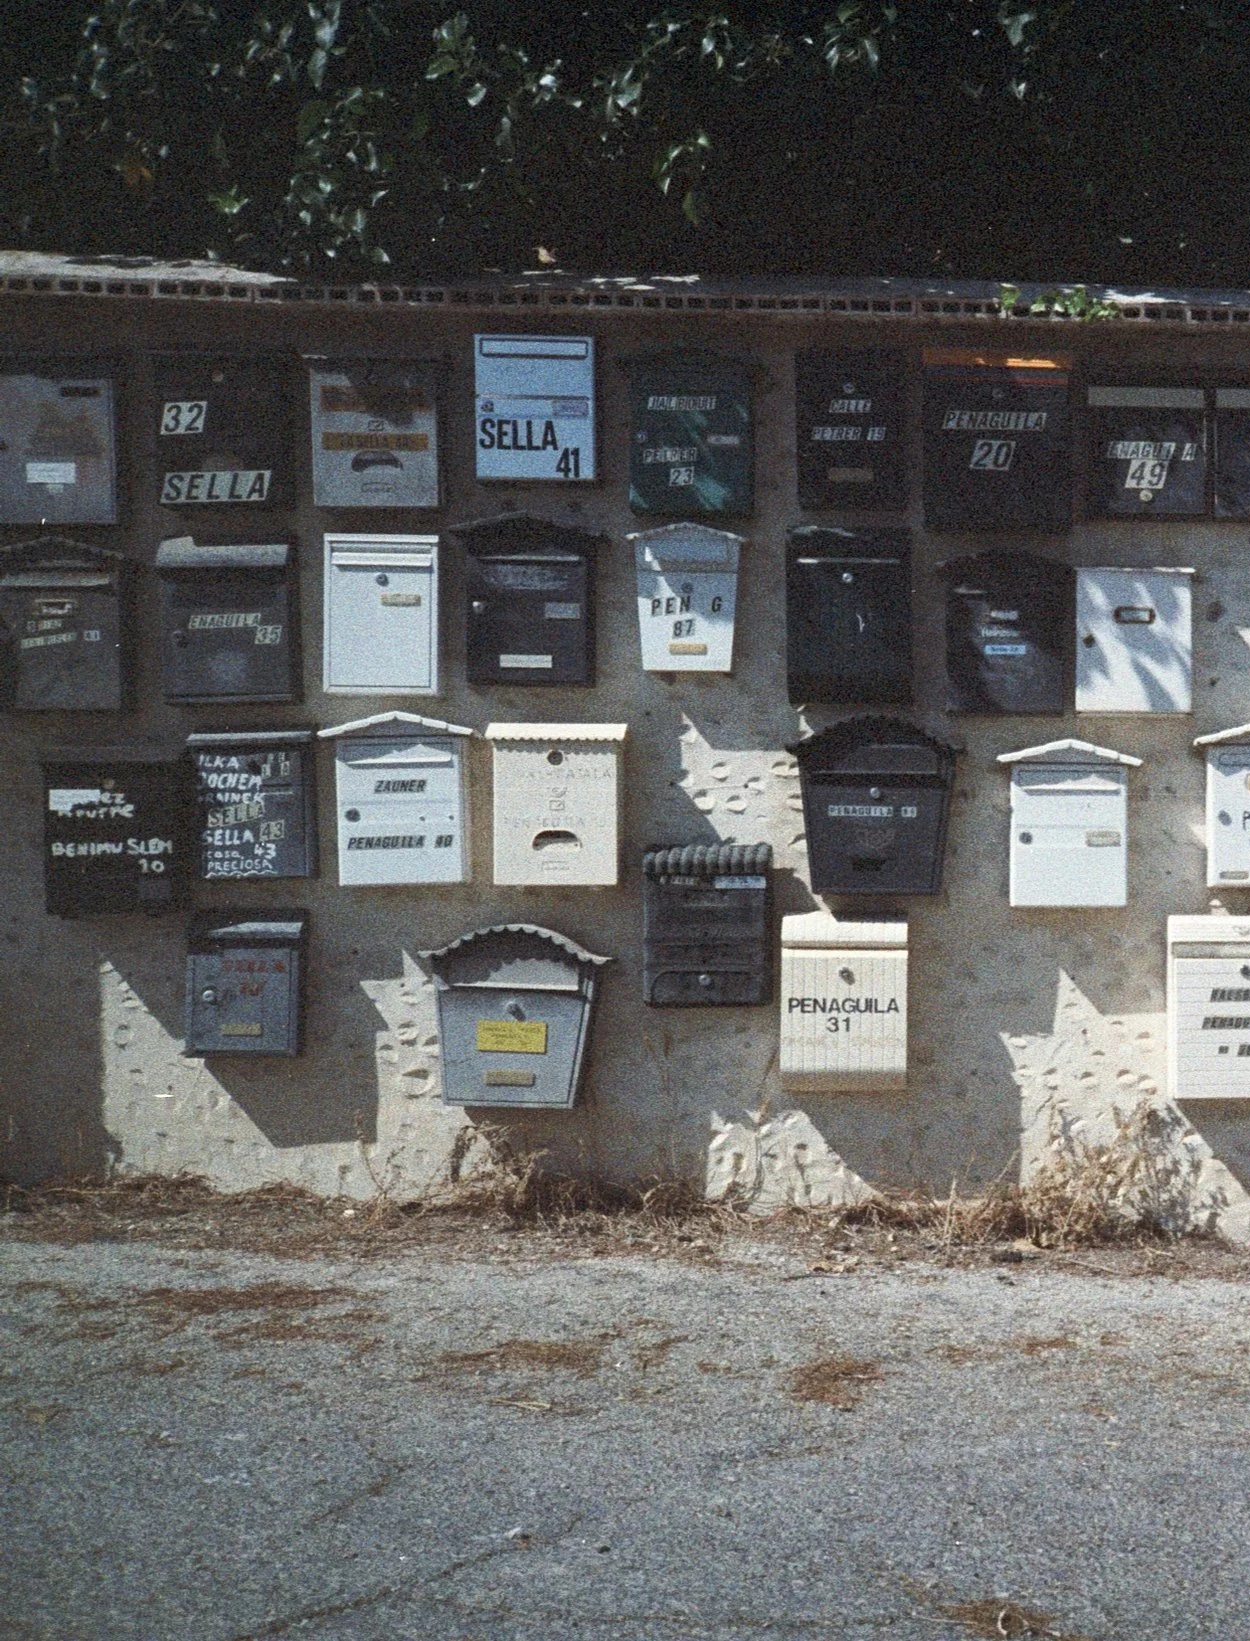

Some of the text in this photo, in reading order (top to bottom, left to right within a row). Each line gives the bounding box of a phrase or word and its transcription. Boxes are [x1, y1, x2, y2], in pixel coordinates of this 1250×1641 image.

[164, 403, 203, 432] 32
[944, 411, 1045, 430] PENAGUILA
[479, 418, 558, 450] SELLA
[556, 448, 580, 478] 41
[974, 441, 1012, 468] 20
[671, 468, 693, 485] 23
[1128, 460, 1165, 487] 49
[164, 473, 266, 501] SELLA
[257, 626, 281, 644] 35
[673, 619, 694, 637] 87
[198, 754, 240, 769] ILKA
[374, 779, 427, 793] ZAUNER
[202, 828, 255, 846] SELLA
[348, 836, 425, 850] PENAGUILA
[253, 842, 277, 859] 43
[138, 858, 165, 873] 10
[787, 997, 900, 1015] PENAGUILA
[825, 1016, 851, 1033] 31
